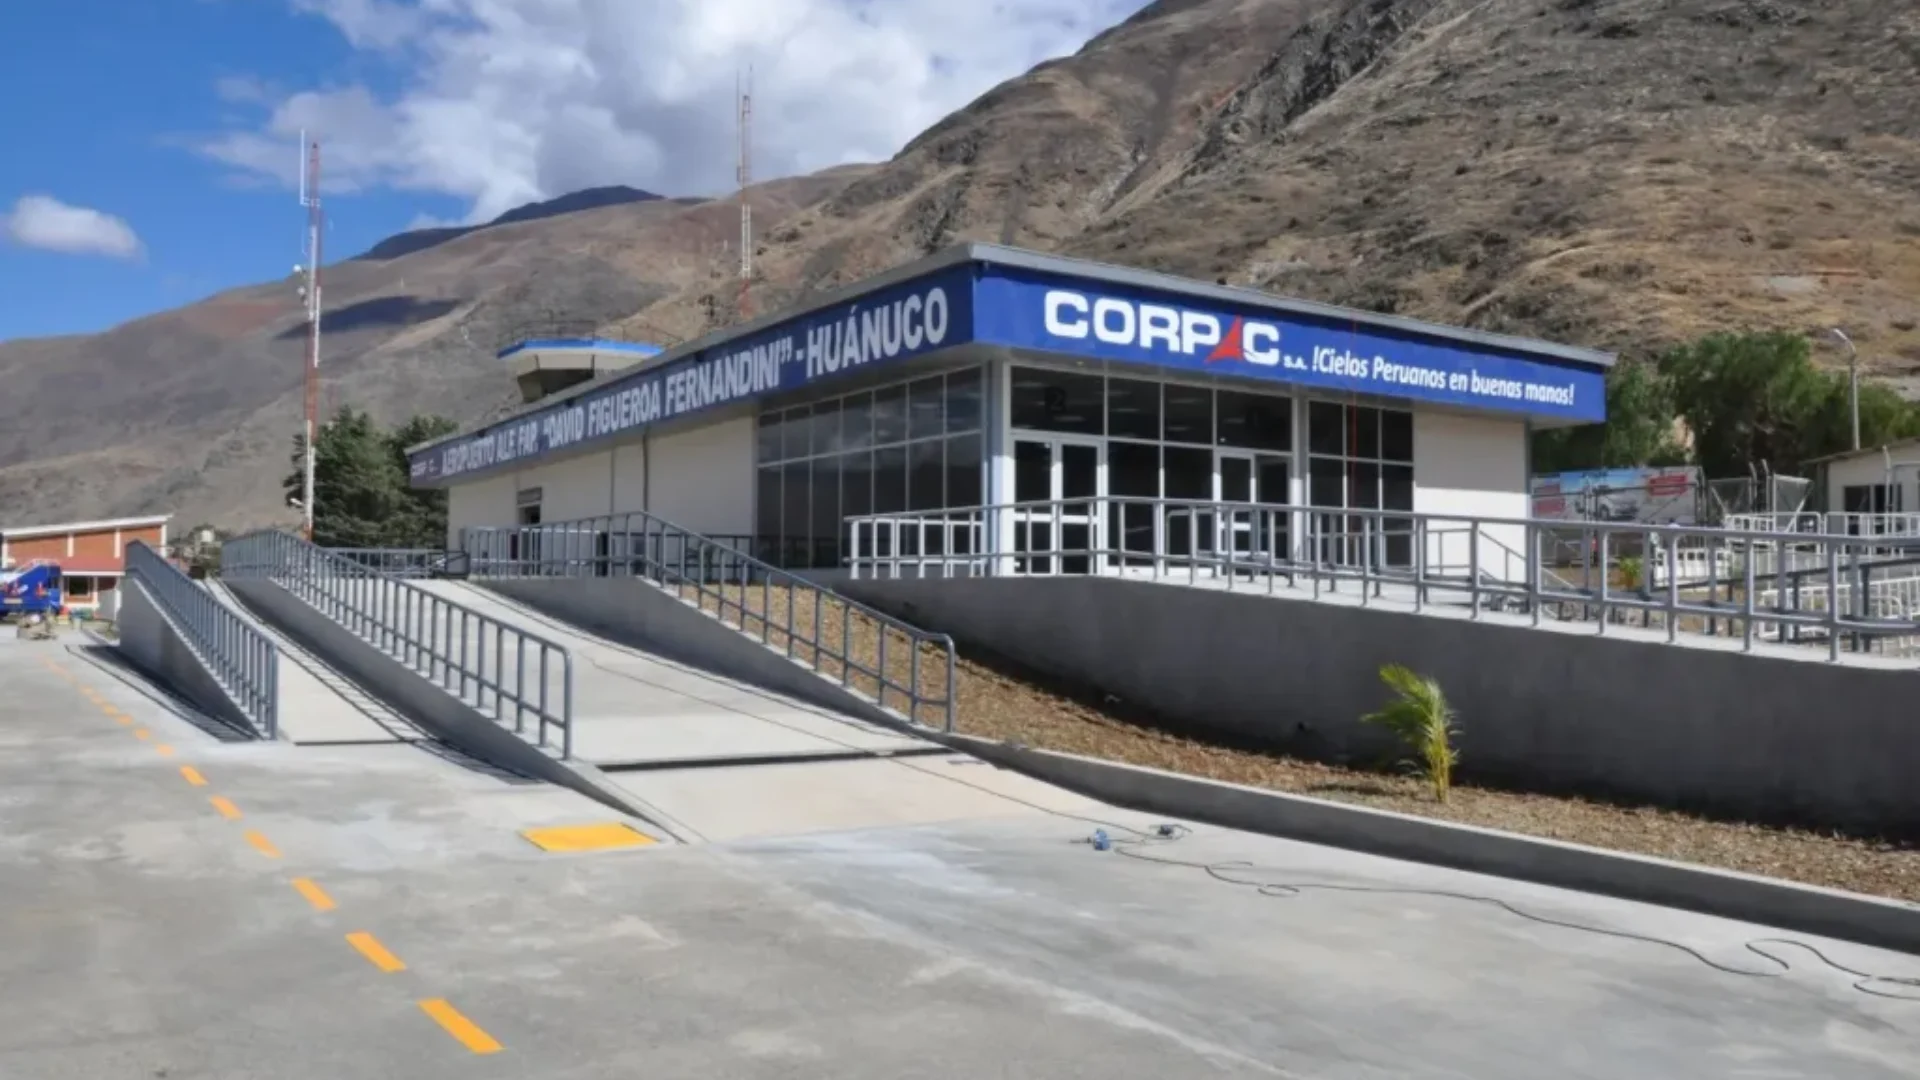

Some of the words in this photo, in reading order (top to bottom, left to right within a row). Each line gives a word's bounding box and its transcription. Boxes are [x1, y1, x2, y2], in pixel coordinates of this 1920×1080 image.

[588, 380, 660, 437] FIGUEROA
[806, 287, 948, 379] HUÁNUCO
[1282, 355, 1308, 371] S.A.
[1312, 345, 1368, 378] !Cielos
[1372, 356, 1446, 389] Peruanos
[1449, 372, 1469, 393] en
[1471, 369, 1522, 399] buenas
[1524, 383, 1575, 405] manos!
